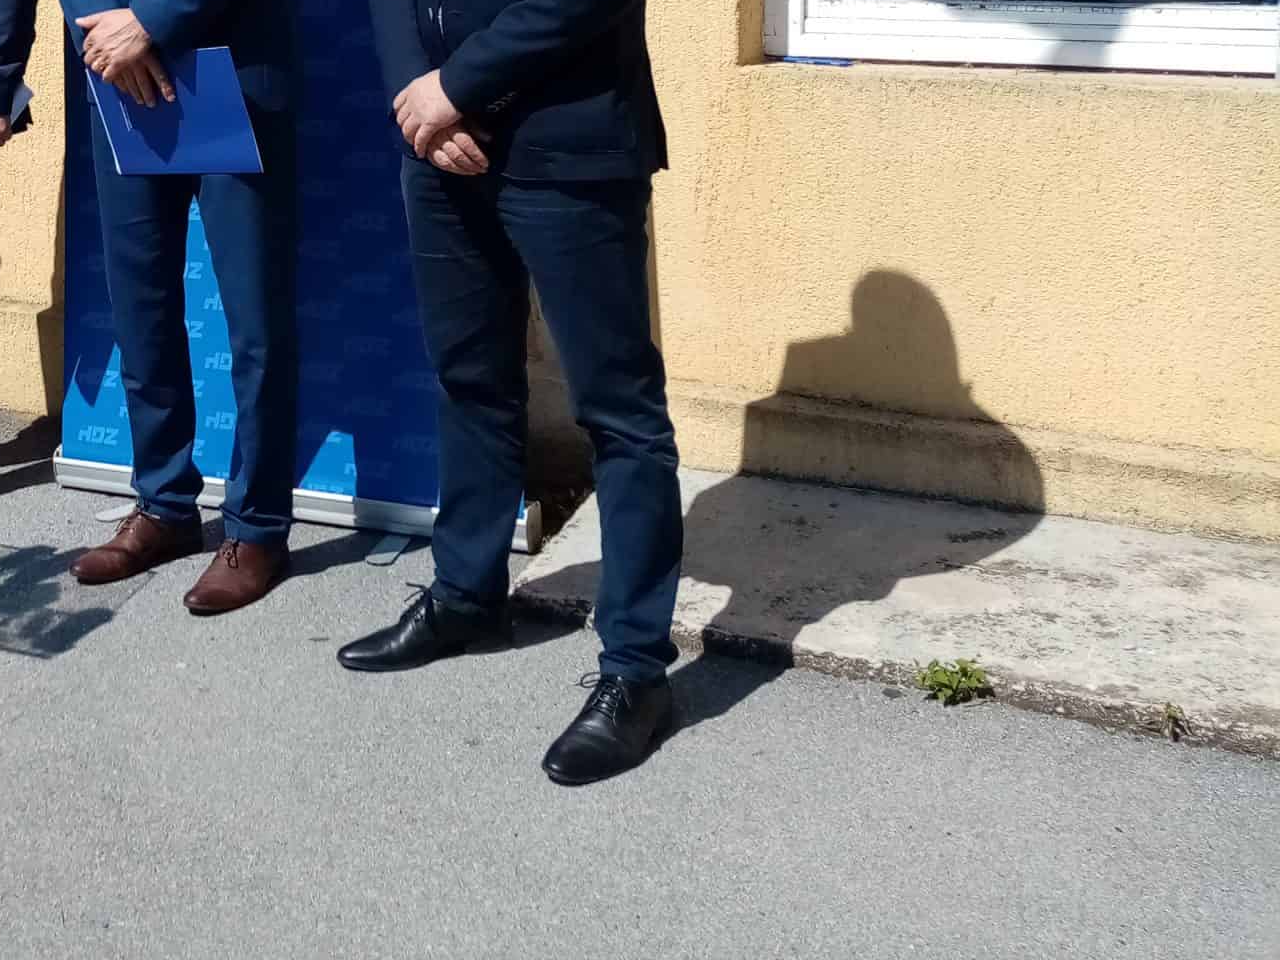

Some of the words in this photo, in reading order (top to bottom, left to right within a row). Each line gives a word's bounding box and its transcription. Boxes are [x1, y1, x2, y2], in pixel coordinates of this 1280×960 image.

[205, 352, 232, 371] HD
[205, 411, 237, 431] HD
[78, 424, 120, 445] HDZ
